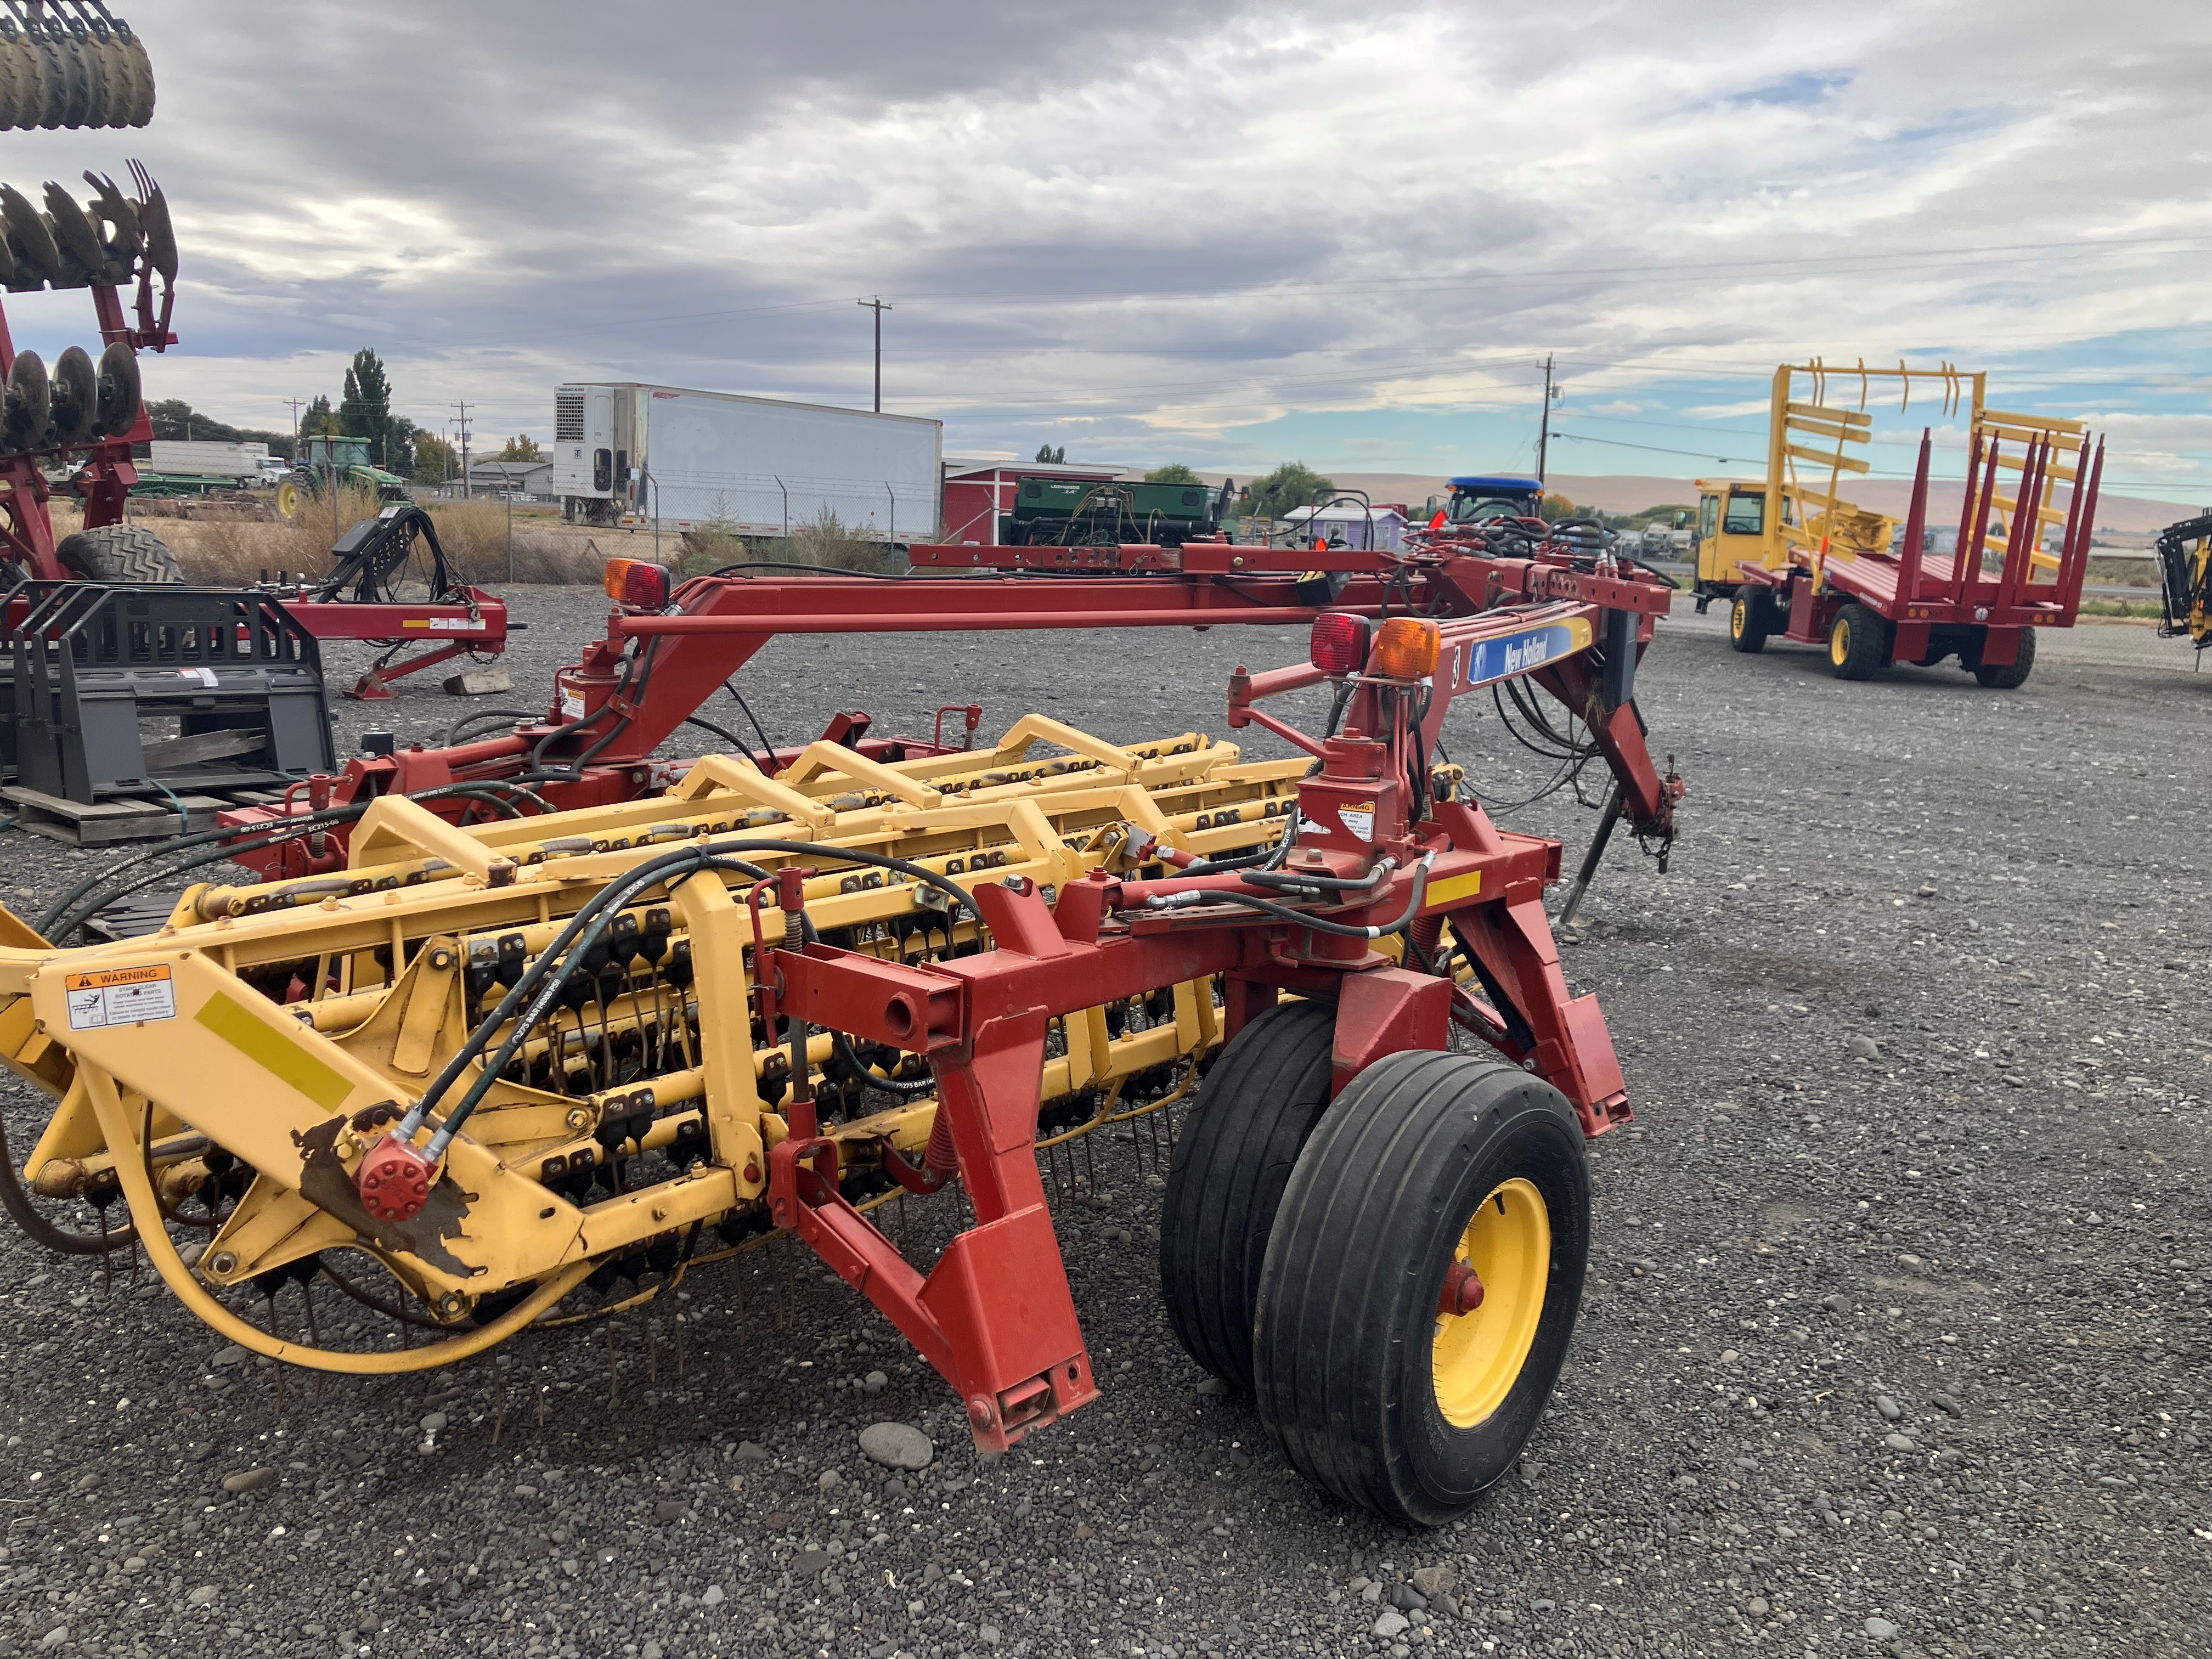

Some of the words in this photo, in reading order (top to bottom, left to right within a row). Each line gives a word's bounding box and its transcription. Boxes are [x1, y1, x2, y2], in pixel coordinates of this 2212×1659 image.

[1504, 643, 1522, 673] New
[1522, 633, 1549, 668] Holland
[240, 822, 273, 833] EC215-08
[268, 833, 292, 843] Winner
[308, 819, 339, 832] EC215-08
[125, 882, 137, 890] 275
[136, 876, 149, 885] BAR
[100, 969, 157, 984] WARNING
[526, 1008, 540, 1023] BAR
